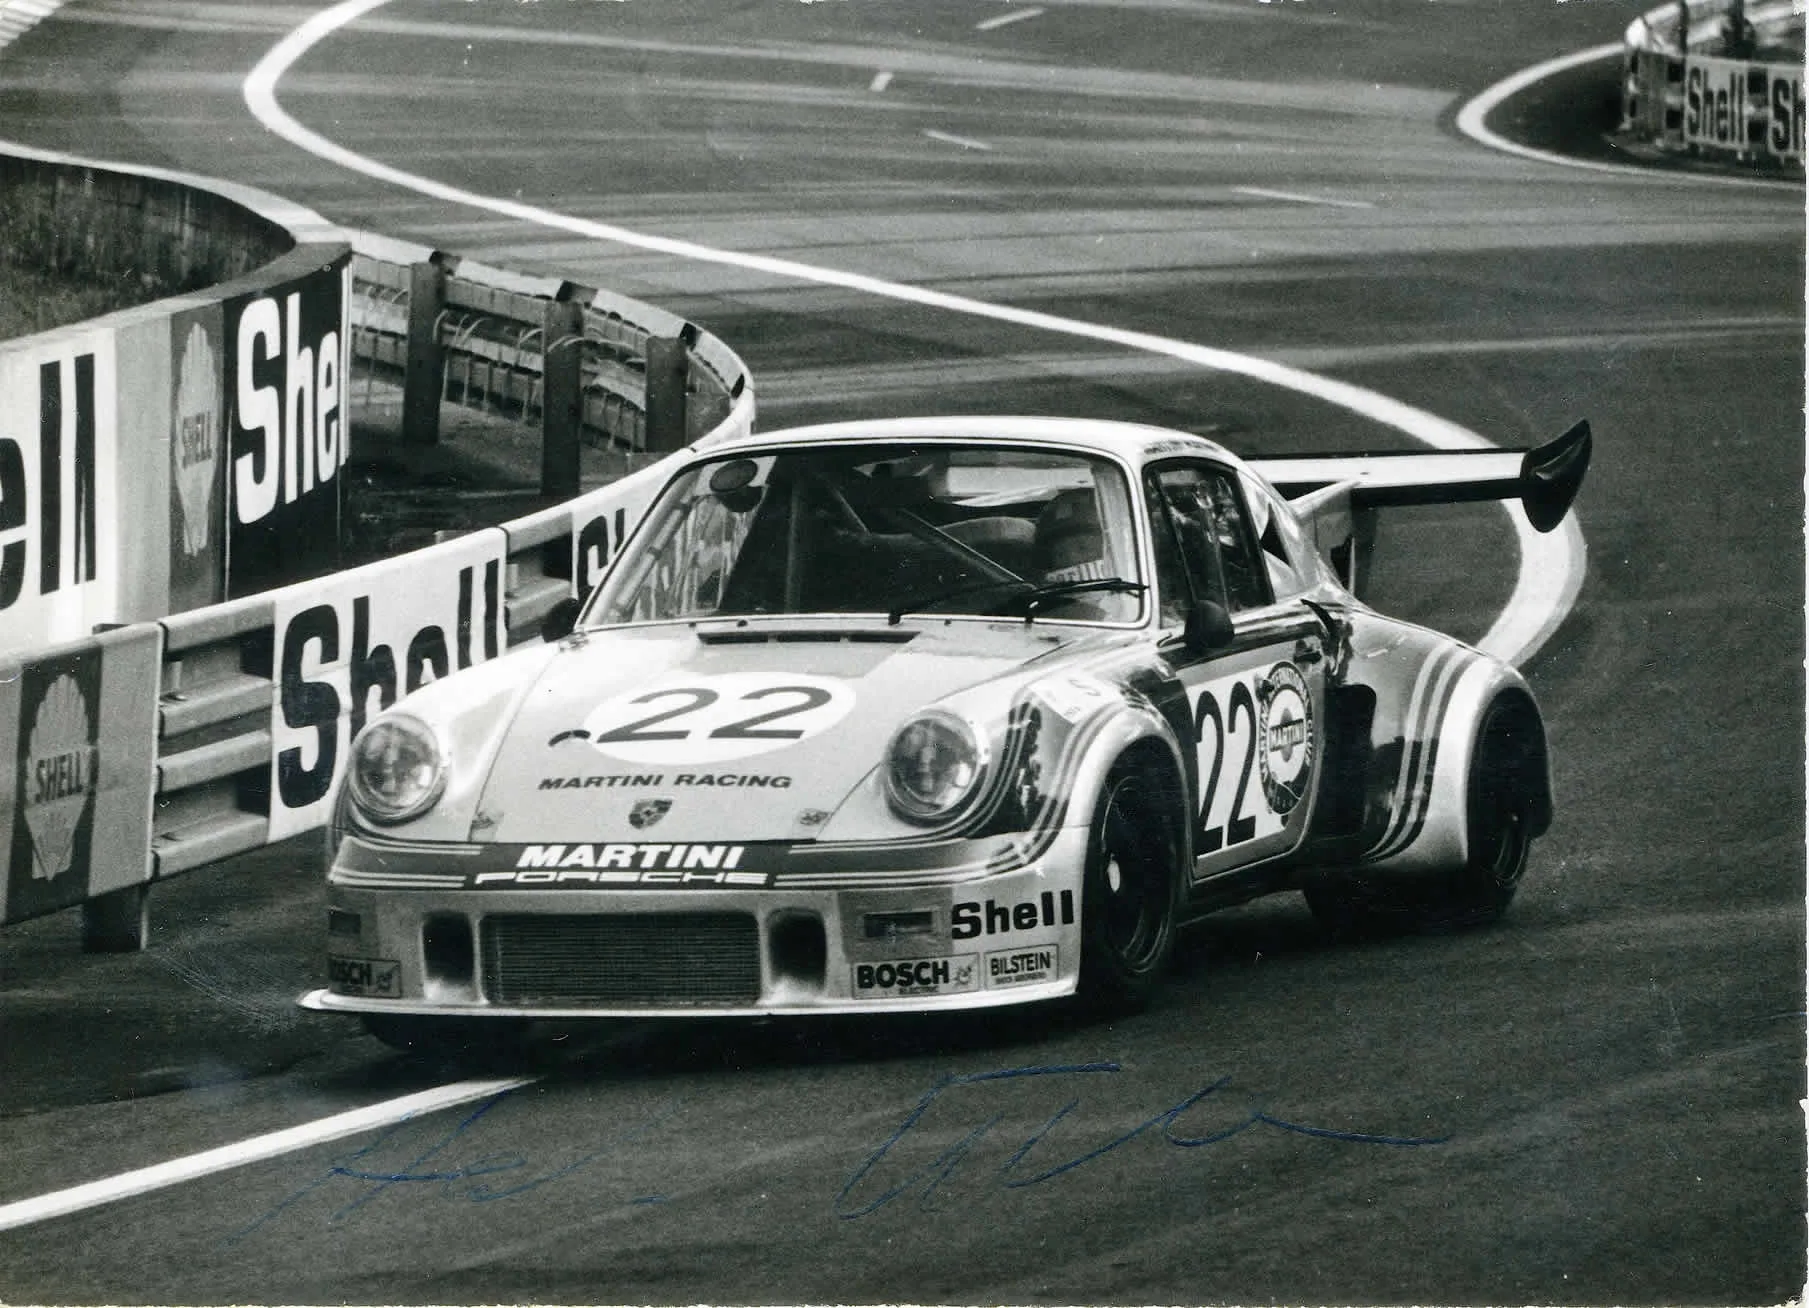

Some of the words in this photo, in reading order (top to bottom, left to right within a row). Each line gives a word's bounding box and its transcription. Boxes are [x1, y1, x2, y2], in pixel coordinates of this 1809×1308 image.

[1688, 67, 1744, 143] Shell
[597, 685, 832, 743] 22
[35, 751, 83, 804] SHELL
[538, 774, 665, 790] MARTINI
[674, 774, 793, 788] RACING
[1195, 680, 1257, 858] 22
[516, 845, 745, 868] MARTINI
[474, 871, 768, 885] PORSCHE
[951, 890, 1075, 940] Shell
[857, 960, 949, 989] BOSCH
[991, 952, 1051, 976] BILSTEIN
